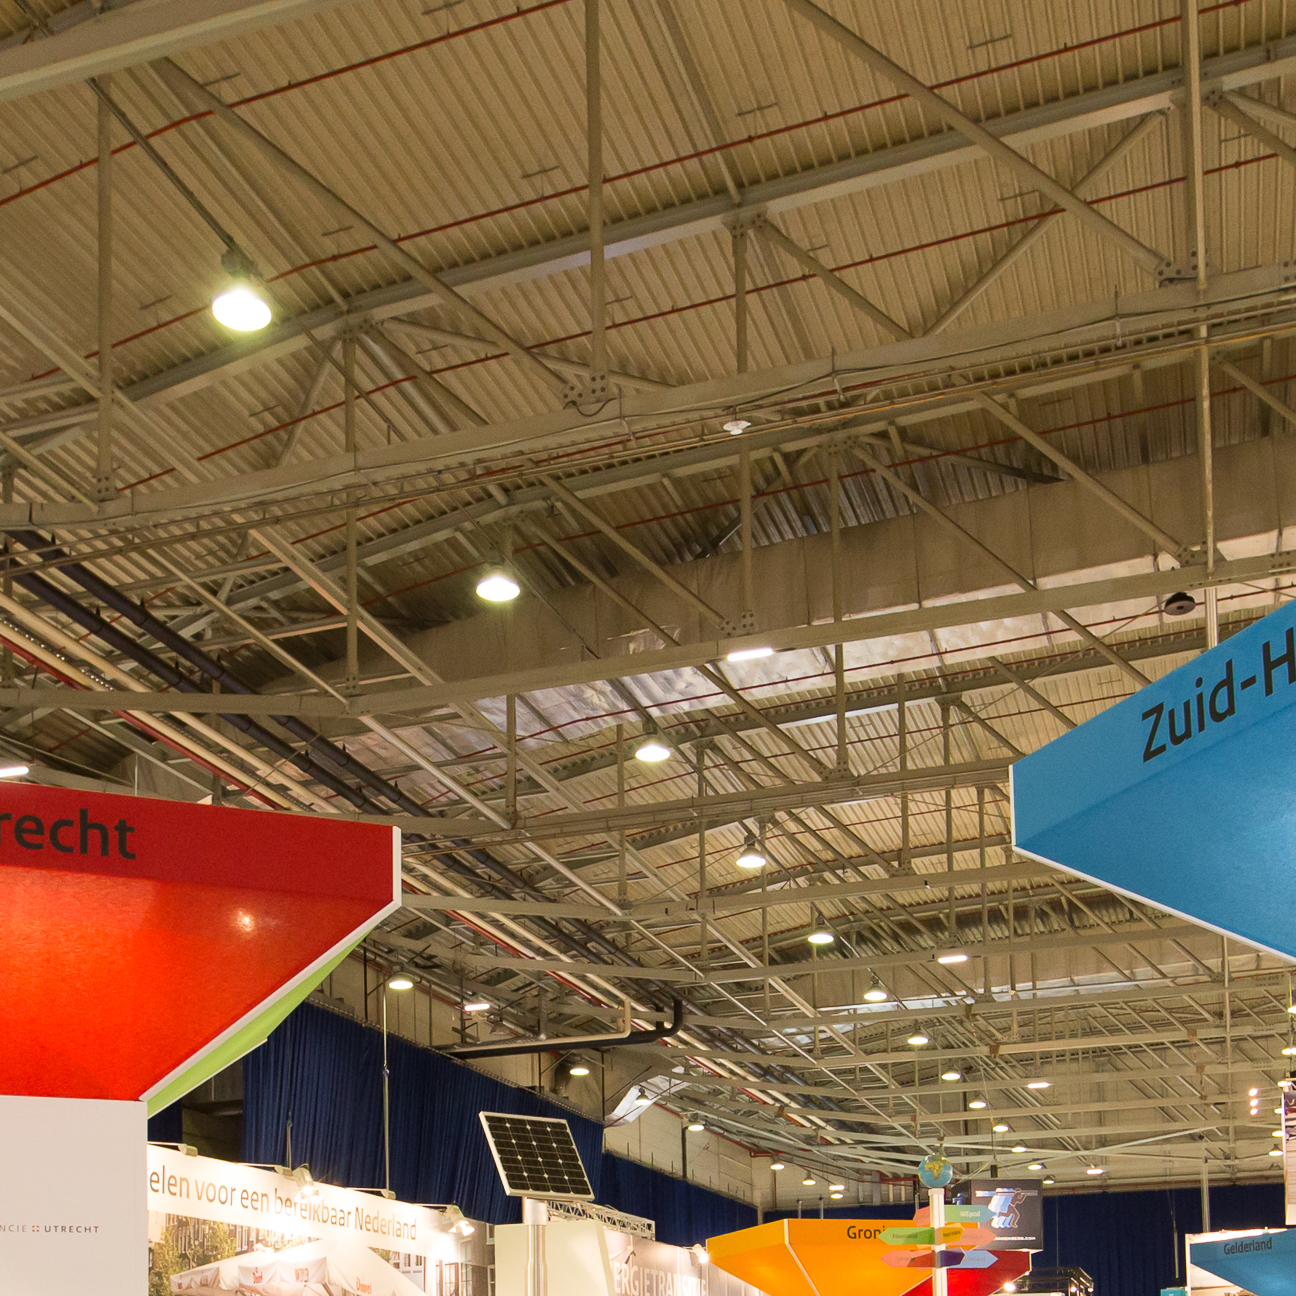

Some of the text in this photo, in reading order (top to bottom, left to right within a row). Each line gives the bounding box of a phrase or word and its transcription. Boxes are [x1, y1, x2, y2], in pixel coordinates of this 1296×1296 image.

[194, 1180, 236, 1208] voor
[240, 1185, 270, 1212] een
[354, 1206, 418, 1242] Nederland
[44, 1225, 100, 1234] UTRECHT
[847, 1225, 885, 1239] Gron
[1223, 1237, 1273, 1255] Gelderland
